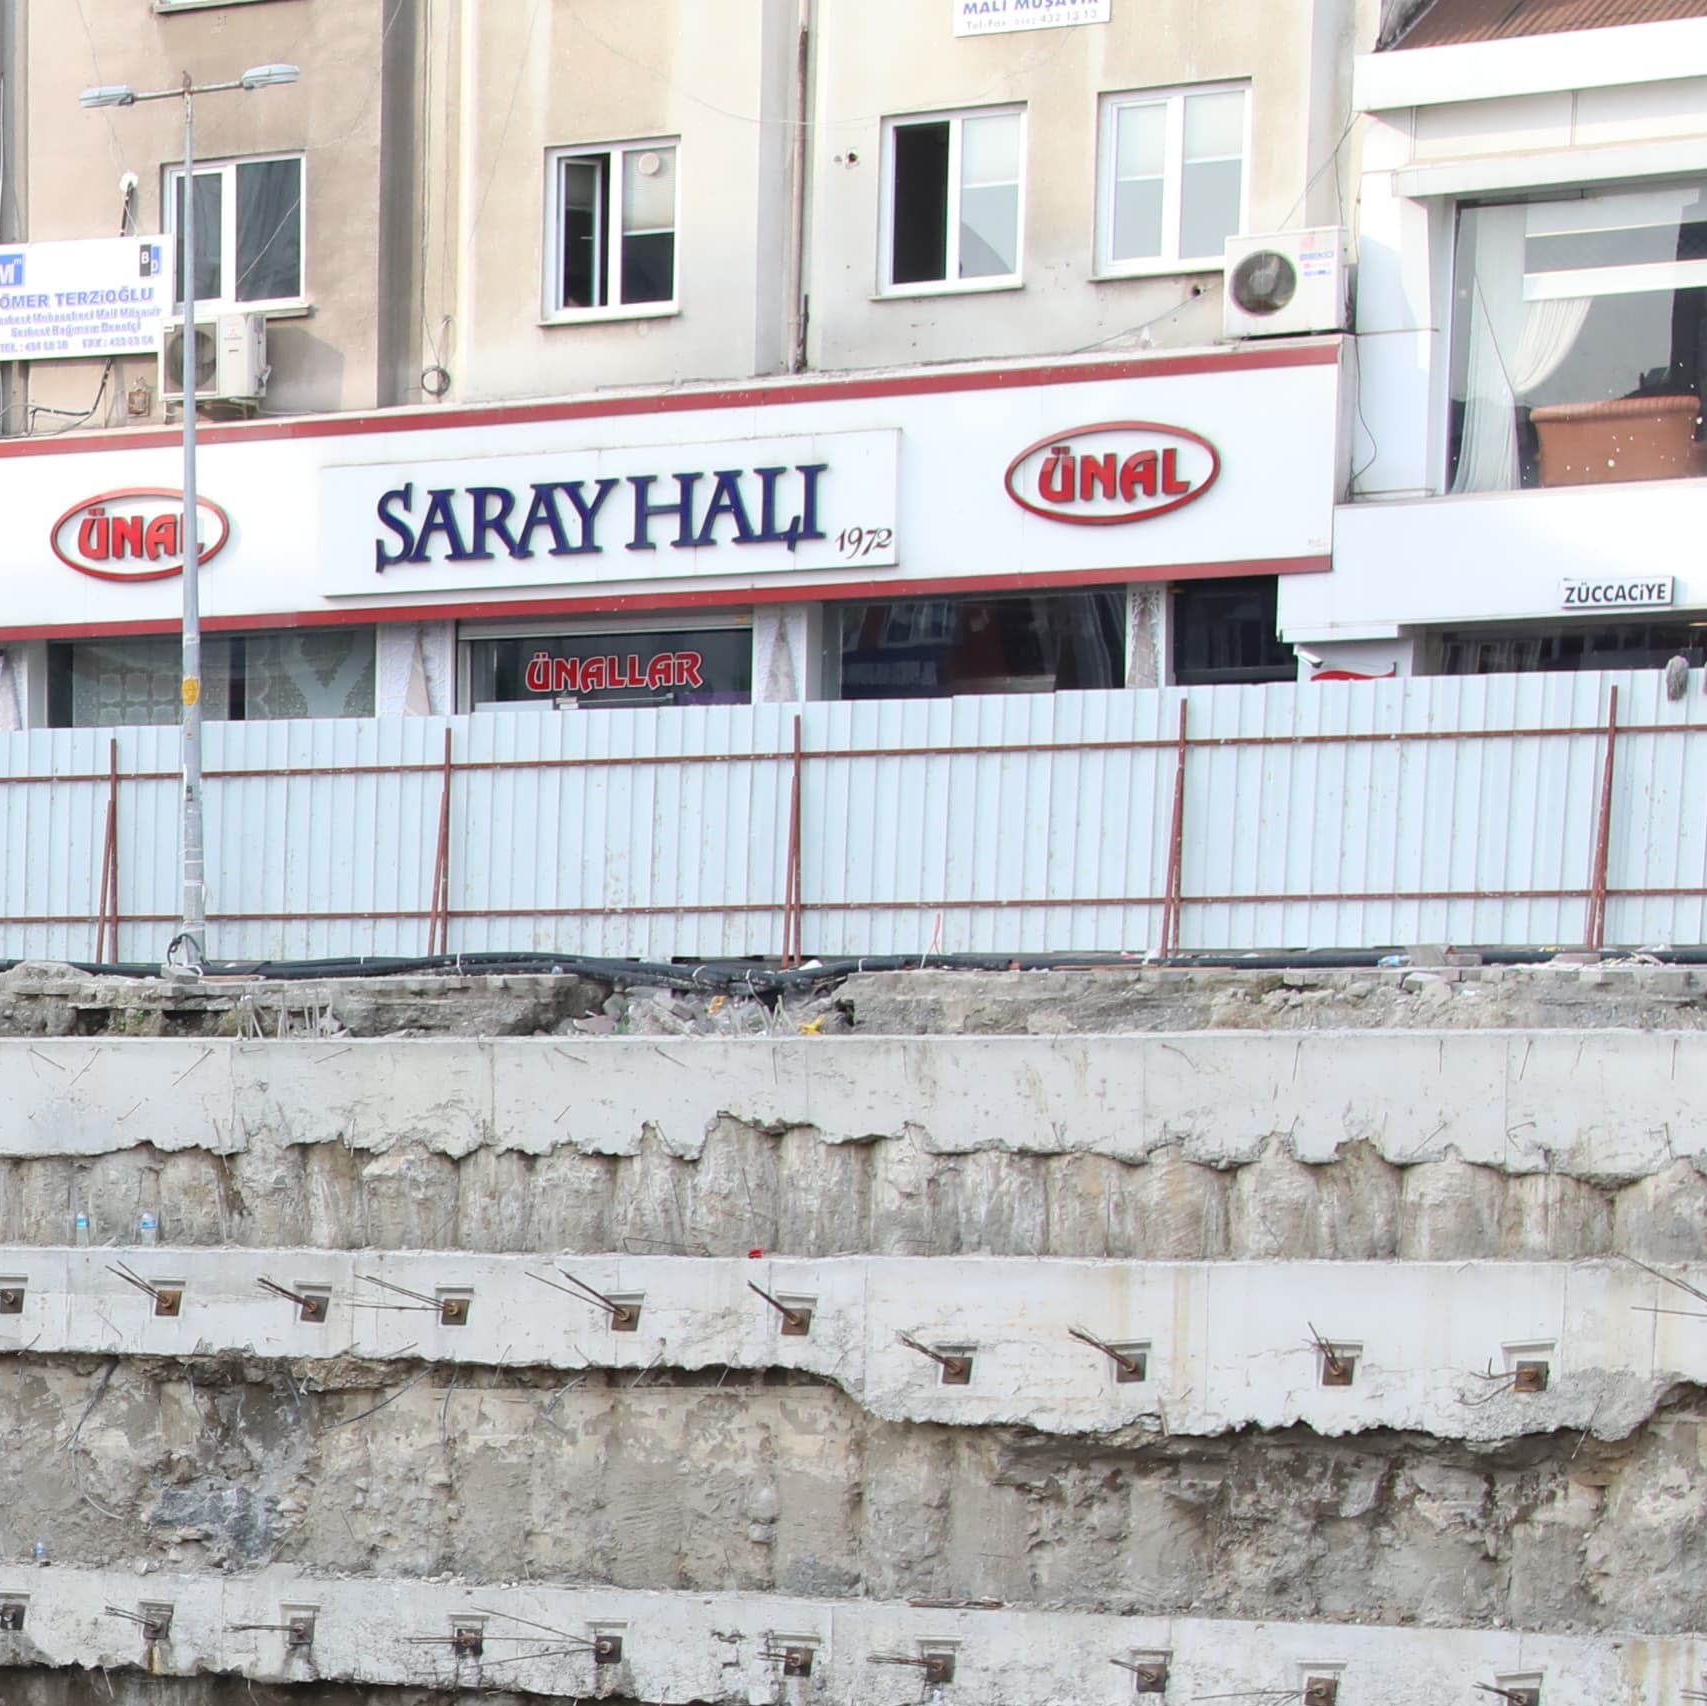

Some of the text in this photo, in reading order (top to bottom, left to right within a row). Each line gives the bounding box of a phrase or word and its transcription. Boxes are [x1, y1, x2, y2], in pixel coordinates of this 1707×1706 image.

[1038, 446, 1192, 504] ÜNAL
[376, 463, 830, 574] SARAY HALI
[836, 526, 894, 561] 1972
[524, 651, 704, 694] ÜNALLAR
